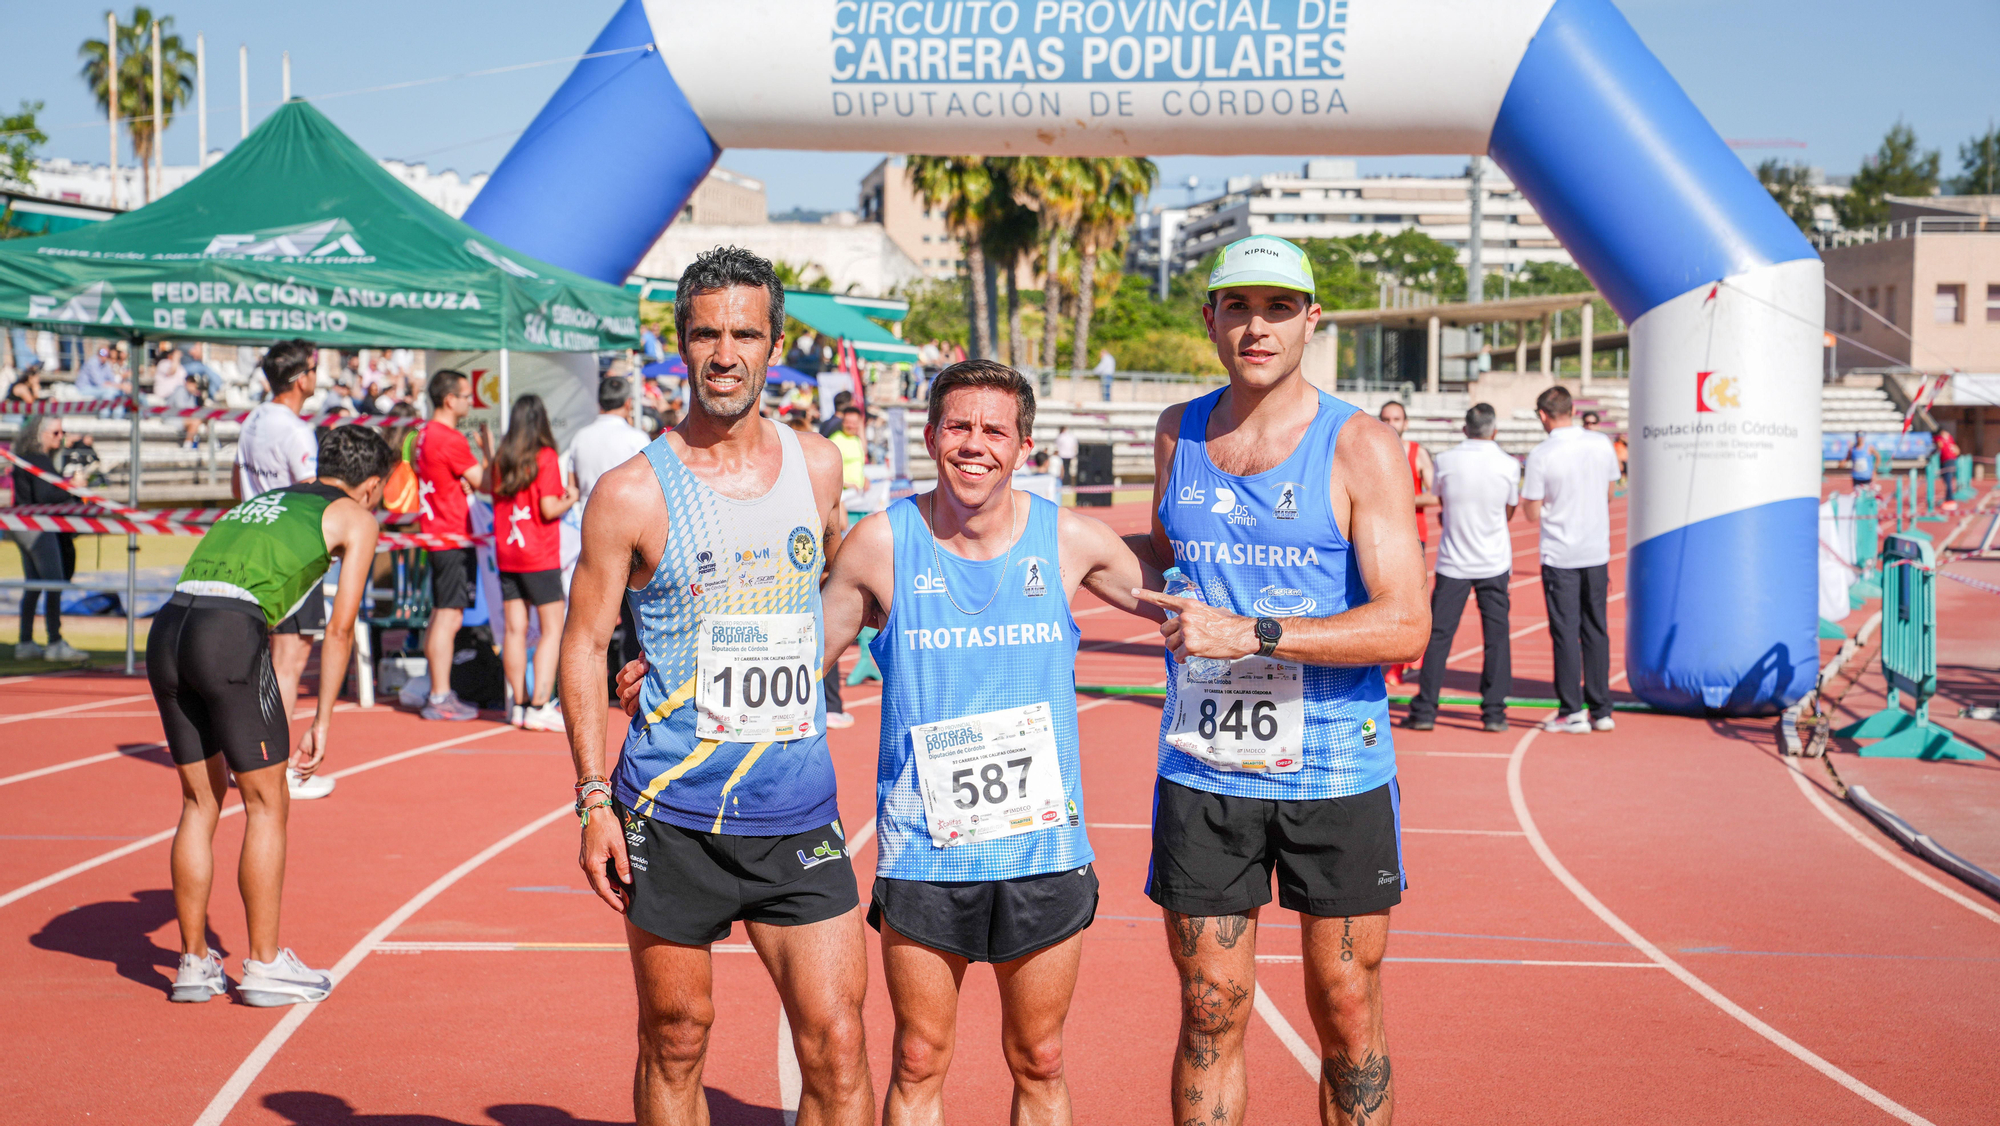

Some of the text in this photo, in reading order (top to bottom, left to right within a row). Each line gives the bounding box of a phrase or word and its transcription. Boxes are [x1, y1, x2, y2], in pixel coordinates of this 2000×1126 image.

[831, 0, 1349, 35] CIRCUITO PROVINCIAL DE
[831, 33, 1345, 81] CARRERAS POPULARES
[833, 80, 1350, 118] DIPUTACIÓN DE CÓRDOBA
[1244, 248, 1279, 257] KIPRUN
[152, 276, 482, 310] FEDERACIÓN ANDALUZA
[153, 308, 348, 332] DE ATLETISMO
[1642, 420, 1799, 439] Diputación de Córdoba
[1227, 513, 1257, 527] Smith
[1235, 505, 1248, 516] DS
[1170, 540, 1319, 567] TROTASIERRA
[711, 631, 768, 645] populares
[712, 626, 760, 635] carreras
[904, 621, 1063, 651] TROTASIERRA
[713, 664, 811, 709] 1000
[1198, 698, 1278, 741] 846
[925, 727, 973, 743] carreras
[926, 732, 983, 753] populares
[928, 744, 985, 760] Diputación de Córdoba
[952, 756, 1033, 810] 587
[1009, 805, 1031, 814] IMDECO
